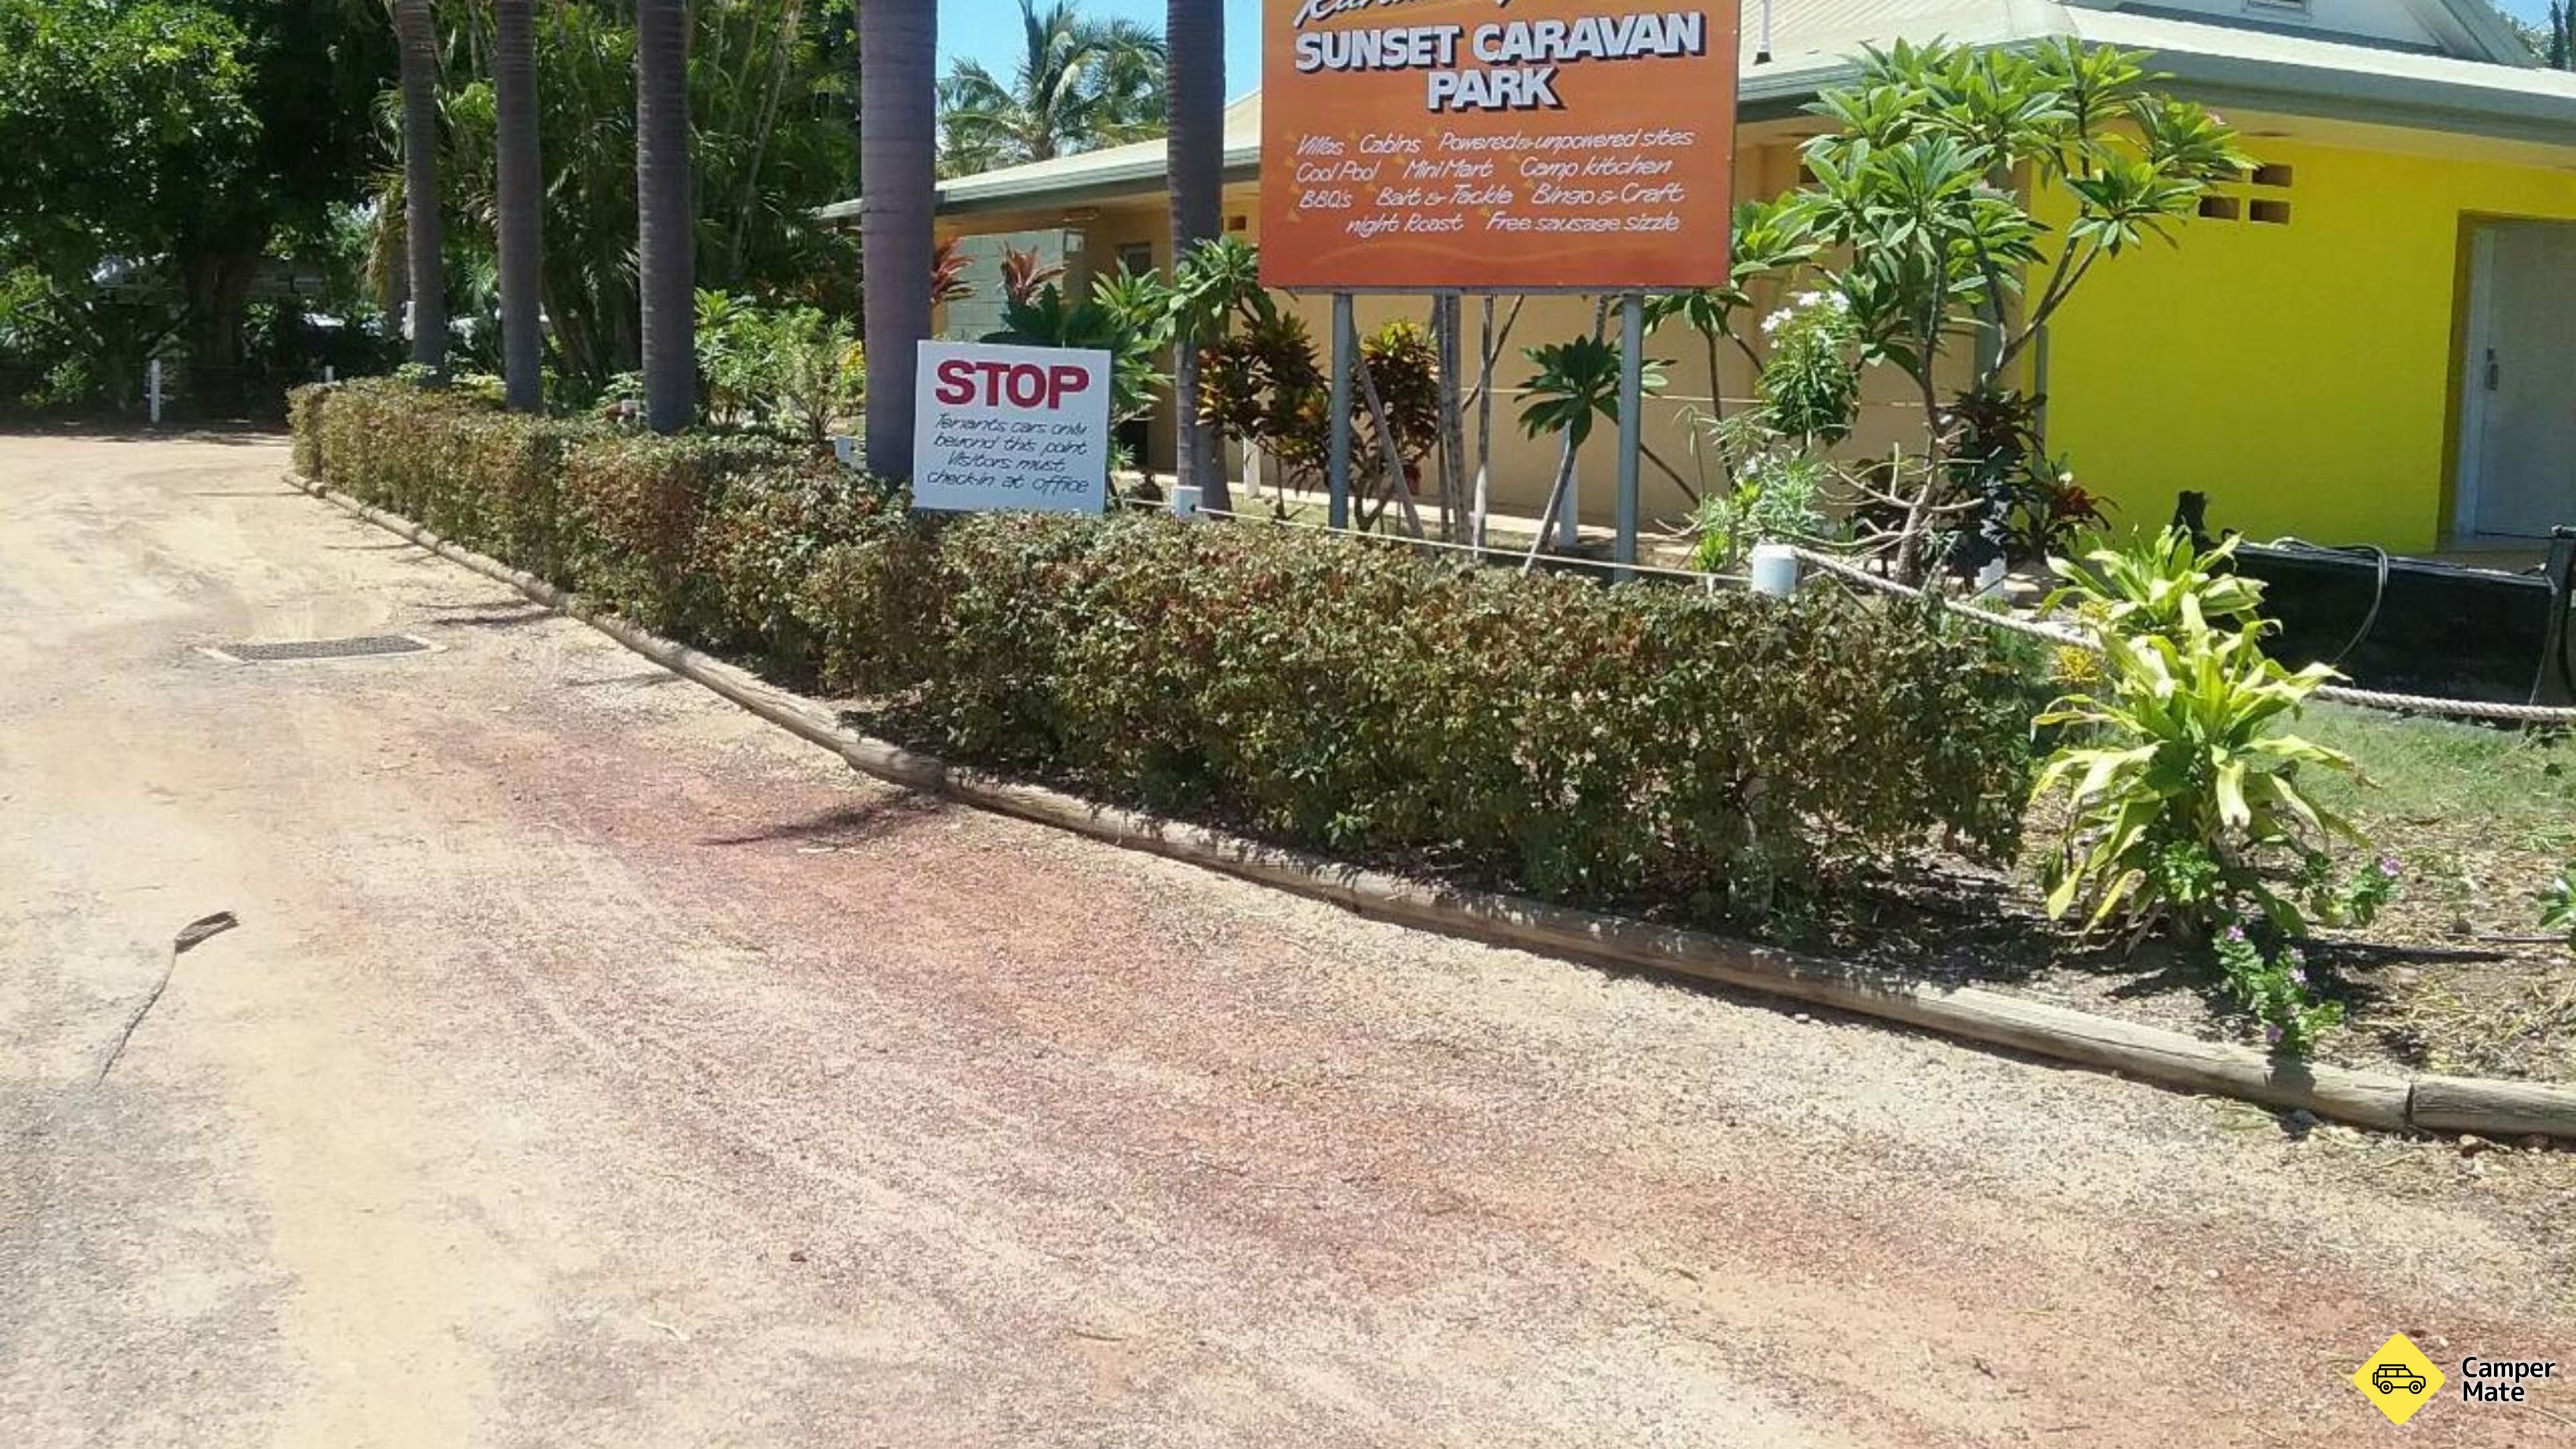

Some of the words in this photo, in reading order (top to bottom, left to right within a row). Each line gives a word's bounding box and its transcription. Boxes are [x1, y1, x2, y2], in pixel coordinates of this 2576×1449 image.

[1295, 25, 1464, 72] SUNSET
[1472, 11, 1706, 66] CARAVAN
[1428, 67, 1565, 111] PARK
[1297, 134, 1346, 156] Villas
[1359, 133, 1423, 154] Cabins
[1640, 128, 1696, 147] sites
[1520, 156, 1578, 182] Camp
[1582, 154, 1672, 176] kitchen
[1299, 189, 1353, 209] BBQ's
[1376, 185, 1422, 207] Bait
[1425, 191, 1447, 207] &
[1449, 183, 1513, 205] Tackle
[1531, 182, 1595, 205] Bingo
[1596, 189, 1618, 204] &
[1621, 182, 1685, 204] Craft
[1346, 213, 1399, 240] night
[1404, 212, 1464, 232] Roast
[1486, 211, 1530, 232] Free
[1535, 216, 1620, 232] sausage
[1624, 211, 1680, 232] sizzle
[935, 359, 1090, 410] STOP
[935, 413, 1007, 432] Tenants
[1011, 422, 1046, 433] cars
[1052, 421, 1087, 435] only
[933, 432, 1000, 449] beyond
[1004, 436, 1036, 451] this
[1040, 440, 1087, 456] point
[947, 450, 1013, 469] Visitors
[1016, 458, 1066, 472] must
[1002, 475, 1025, 489] at
[1032, 475, 1089, 497] office
